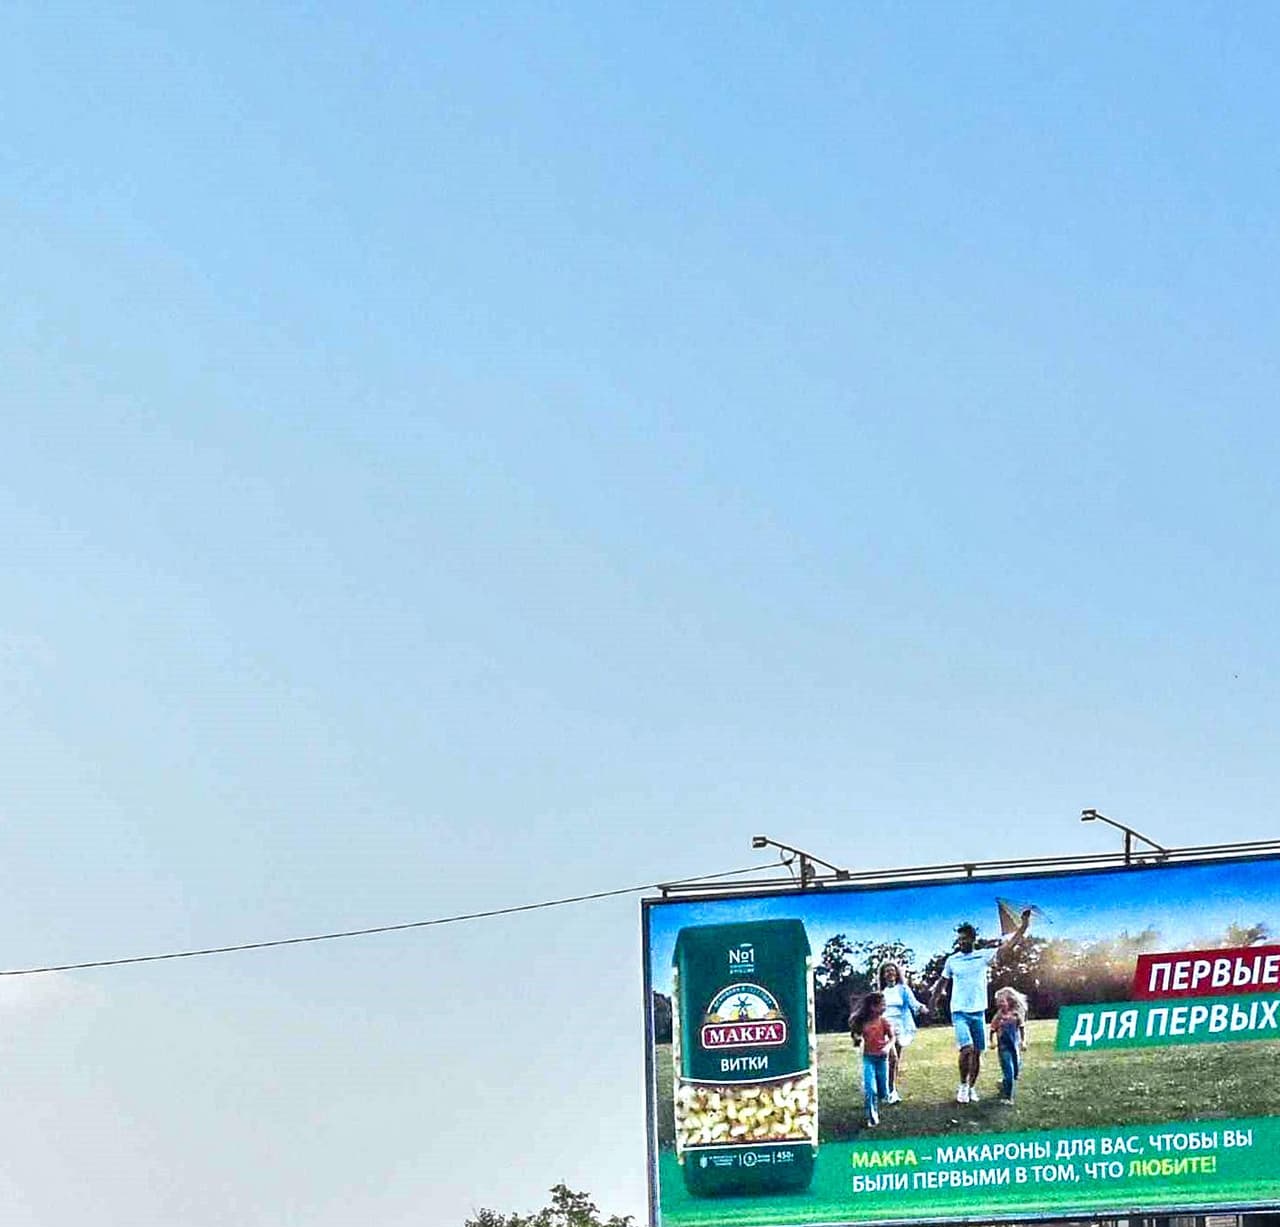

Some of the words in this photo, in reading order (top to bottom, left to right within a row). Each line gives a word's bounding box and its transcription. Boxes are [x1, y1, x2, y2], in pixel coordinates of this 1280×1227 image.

[1148, 954, 1280, 992] ПЕРВЫЕ
[708, 1024, 778, 1044] MAKFA
[1069, 1009, 1138, 1047] ДЛЯ
[1145, 1000, 1280, 1037] ПЕРВЫХ
[721, 1056, 768, 1072] ВИТКИ
[852, 1149, 917, 1168] MAKFA
[936, 1141, 1051, 1164] МАКАРОНЫ
[1055, 1138, 1095, 1161] ДЛЯ
[1100, 1135, 1144, 1156] ВАС,
[1149, 1131, 1218, 1152] ЧТОБЫ
[1223, 1129, 1253, 1148] ВЫ
[852, 1173, 908, 1193] БЫЛИ
[913, 1167, 1010, 1190] ПЕРВЫМИ
[1015, 1166, 1027, 1184] В
[1031, 1164, 1080, 1183] ТОМ,
[1085, 1161, 1124, 1180] ЧТО
[1128, 1155, 1217, 1177] ЛЮБИТЕ!
